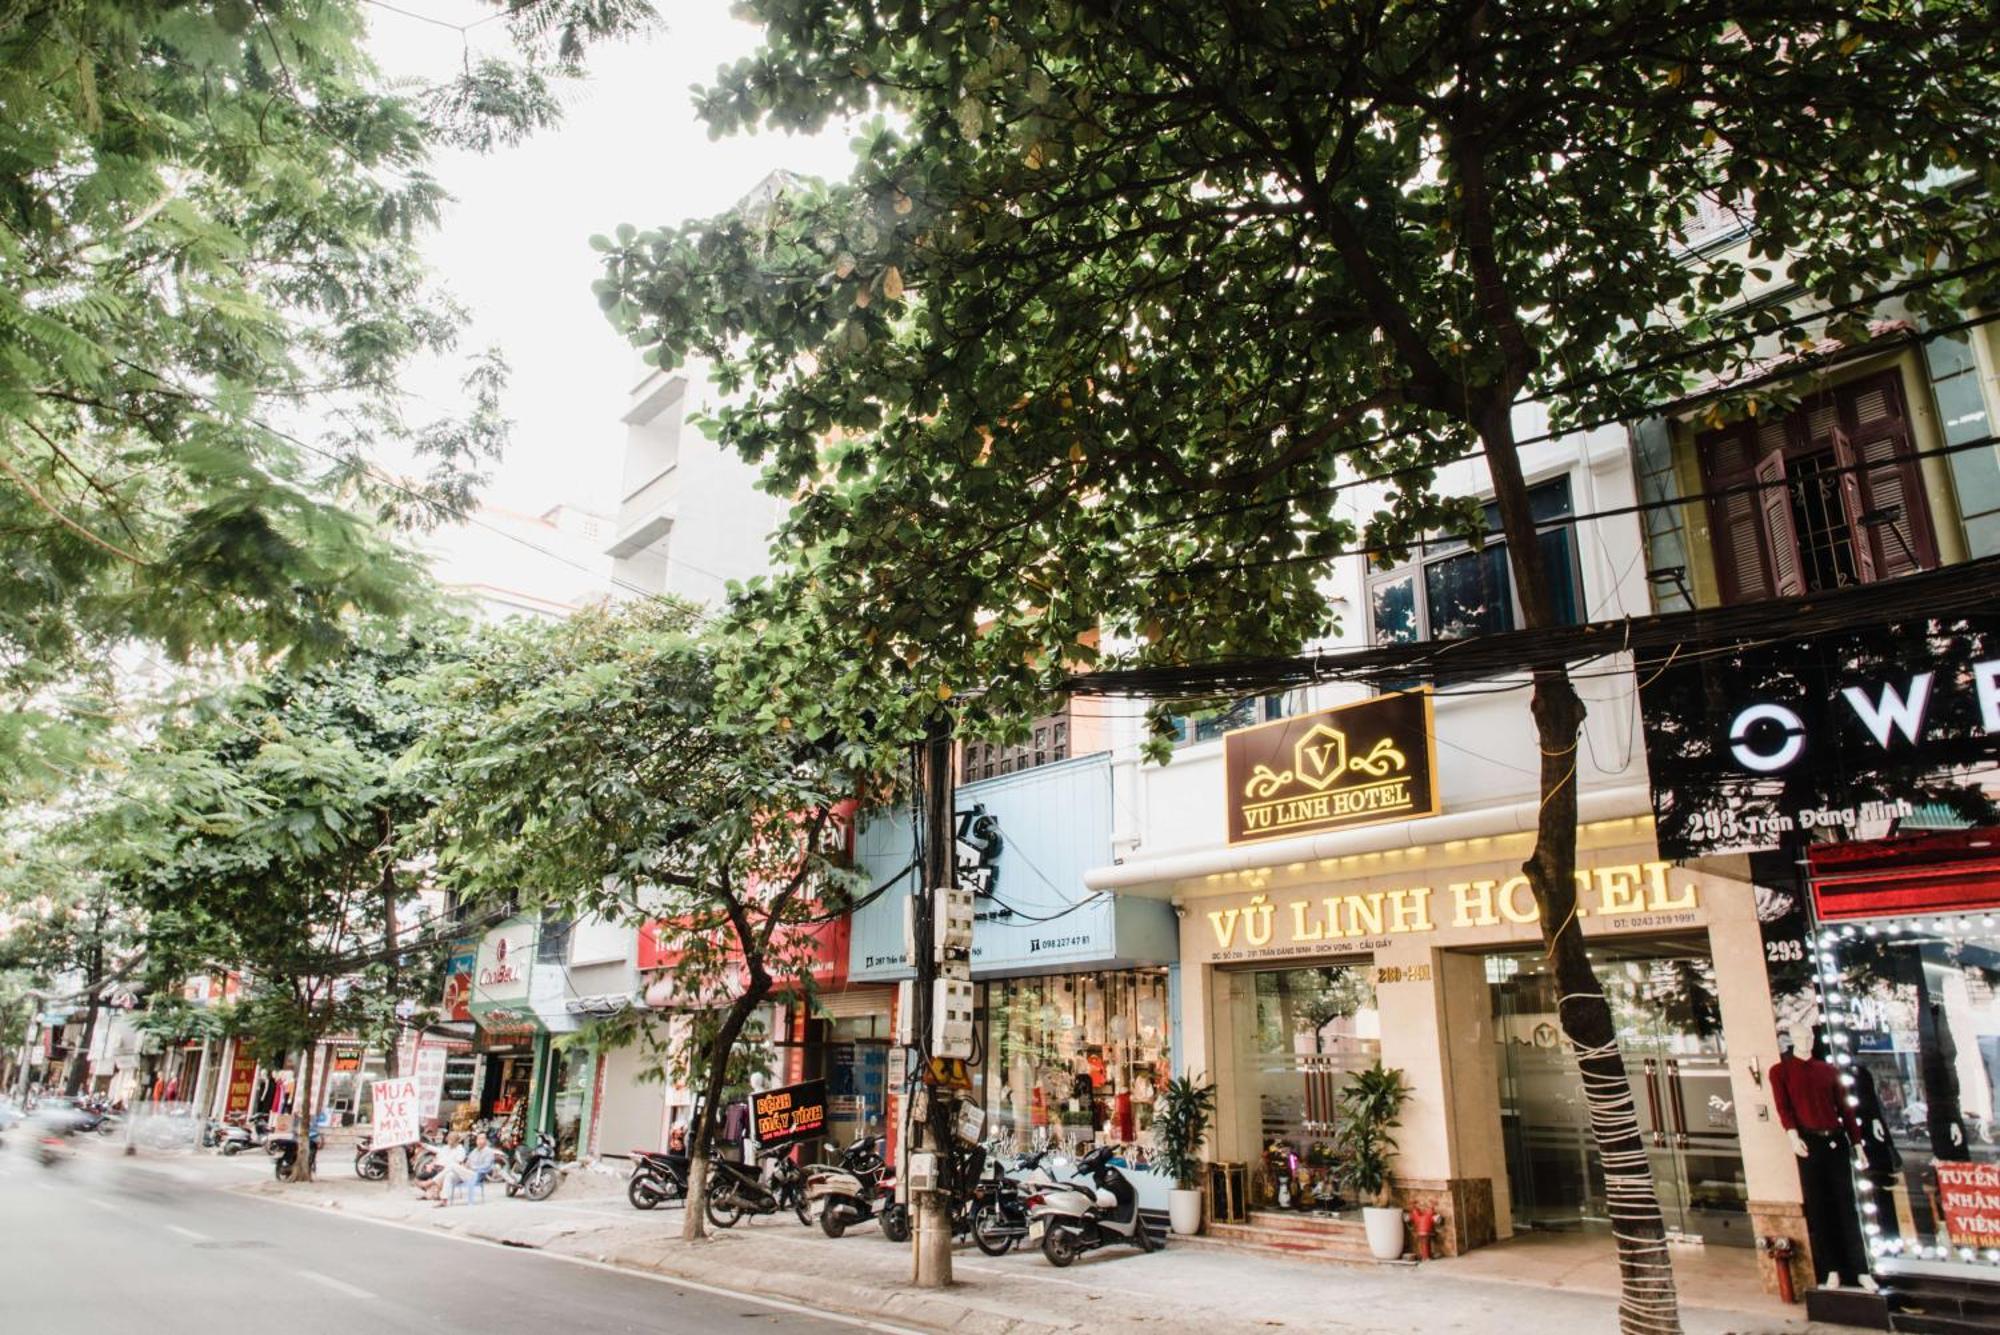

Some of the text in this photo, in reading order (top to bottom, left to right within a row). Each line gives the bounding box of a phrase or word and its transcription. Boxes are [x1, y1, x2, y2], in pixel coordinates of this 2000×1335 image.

[1304, 743, 1335, 775] V
[1277, 796, 1330, 824] LINH
[1333, 783, 1410, 815] HOTEL
[1688, 808, 1739, 842] 293
[1208, 893, 1276, 948] VŨ
[1290, 887, 1435, 941] LINH
[1766, 940, 1803, 963] 293
[374, 1082, 416, 1101] MUA
[385, 1101, 407, 1117] XE
